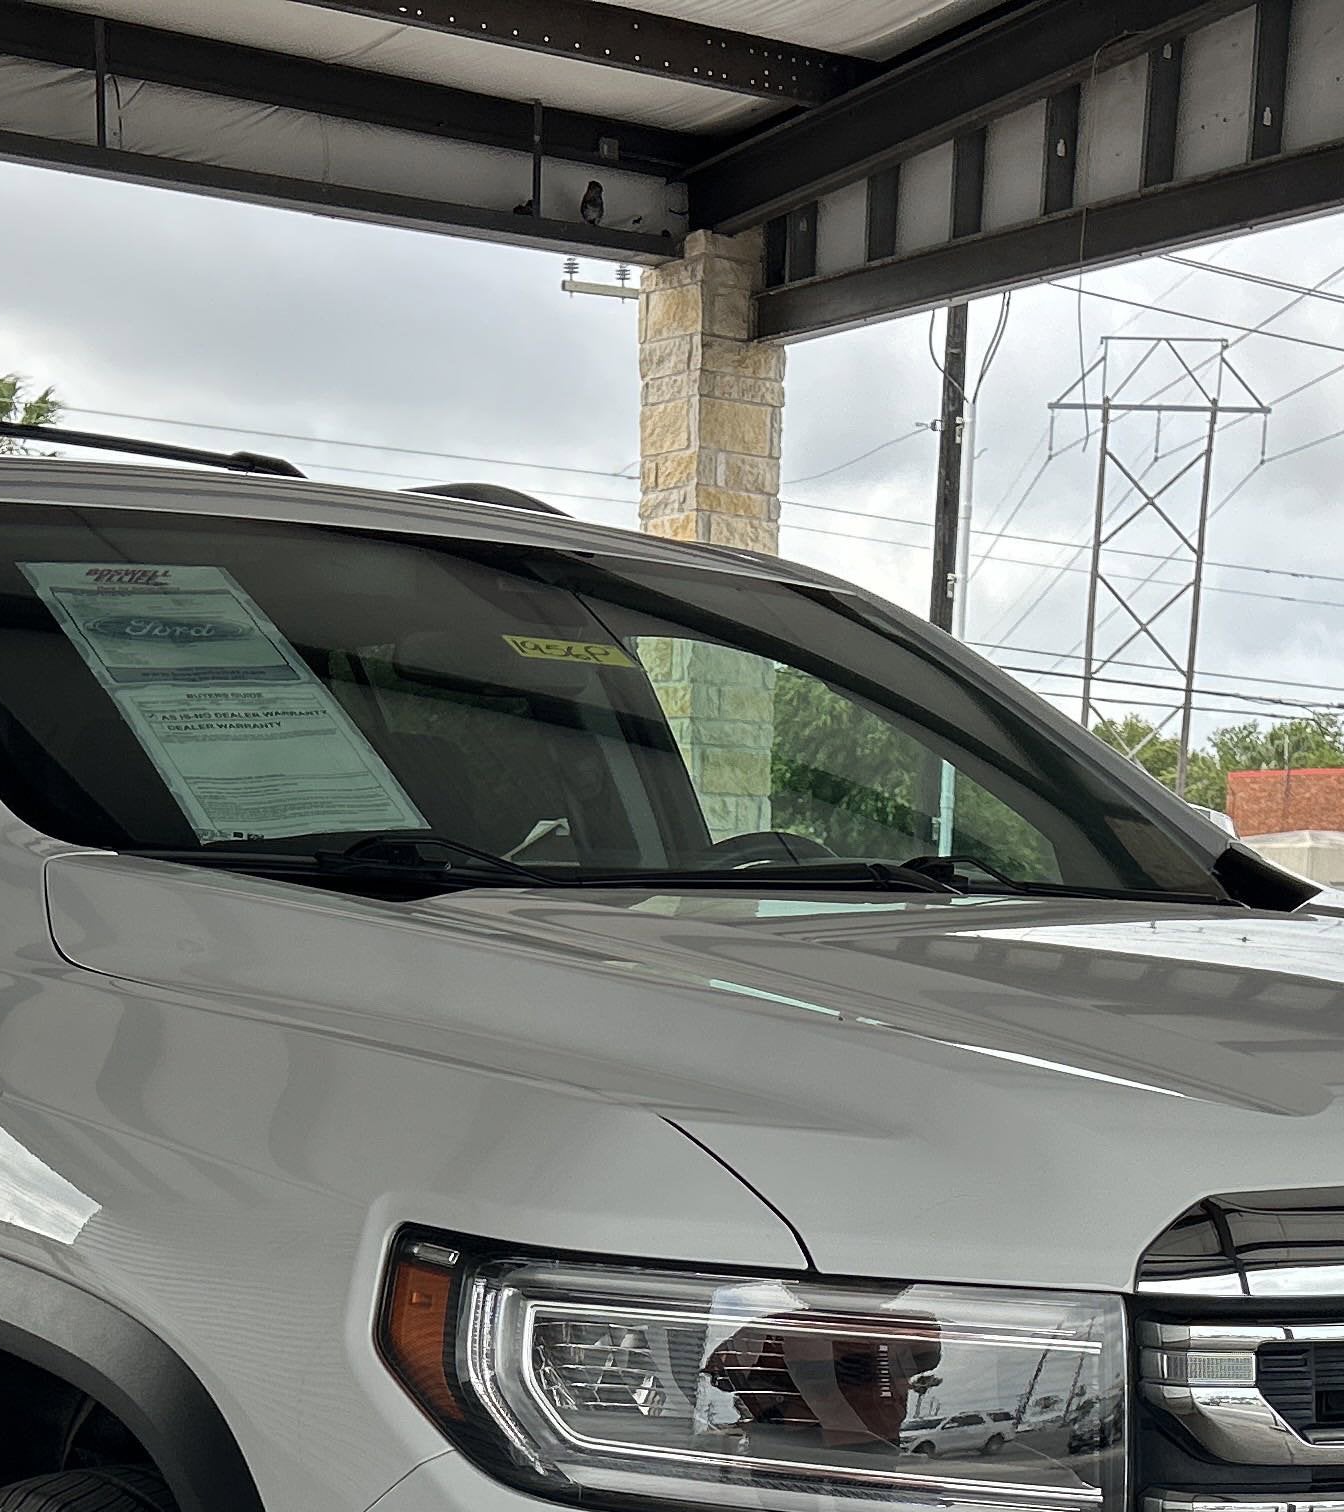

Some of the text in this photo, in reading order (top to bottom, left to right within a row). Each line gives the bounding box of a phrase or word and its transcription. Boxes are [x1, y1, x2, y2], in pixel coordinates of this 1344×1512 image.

[124, 618, 216, 637] Ford
[214, 711, 259, 719] DEALER
[263, 709, 327, 718] WARRANTY
[167, 721, 281, 731] DEALER WARRANTY
